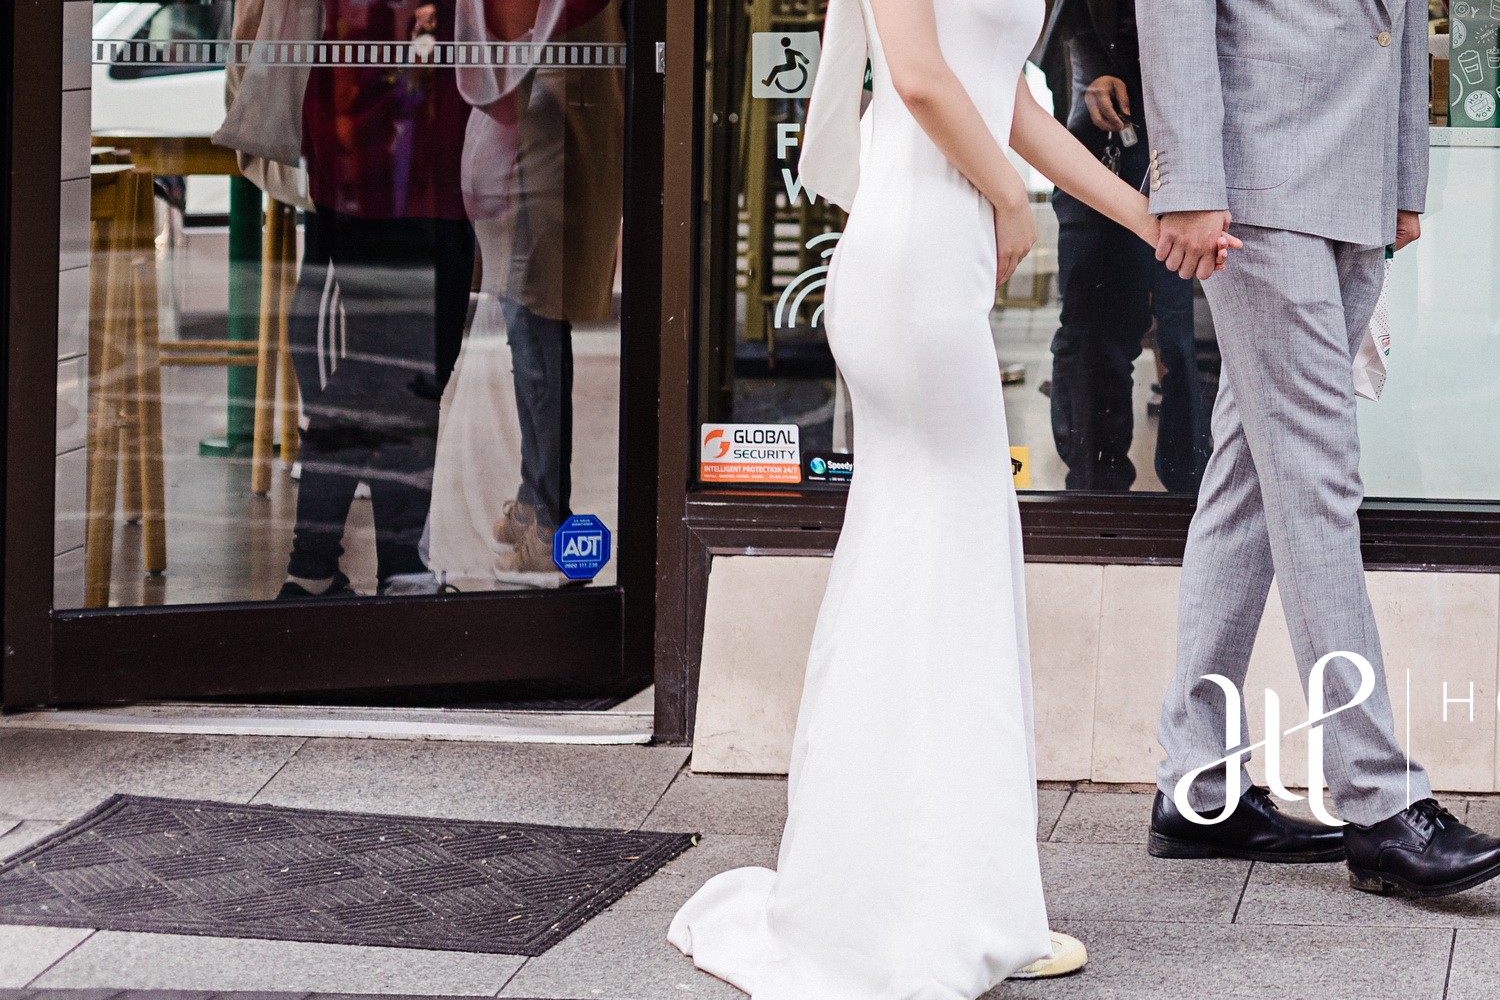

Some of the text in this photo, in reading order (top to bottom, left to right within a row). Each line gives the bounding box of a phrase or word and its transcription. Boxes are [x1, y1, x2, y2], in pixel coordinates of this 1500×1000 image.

[734, 429, 796, 445] GLOBAL
[734, 449, 795, 460] SECURITY
[704, 465, 742, 473] INTELLIGENT
[783, 466, 798, 474] 24/7
[563, 536, 602, 556] ADT
